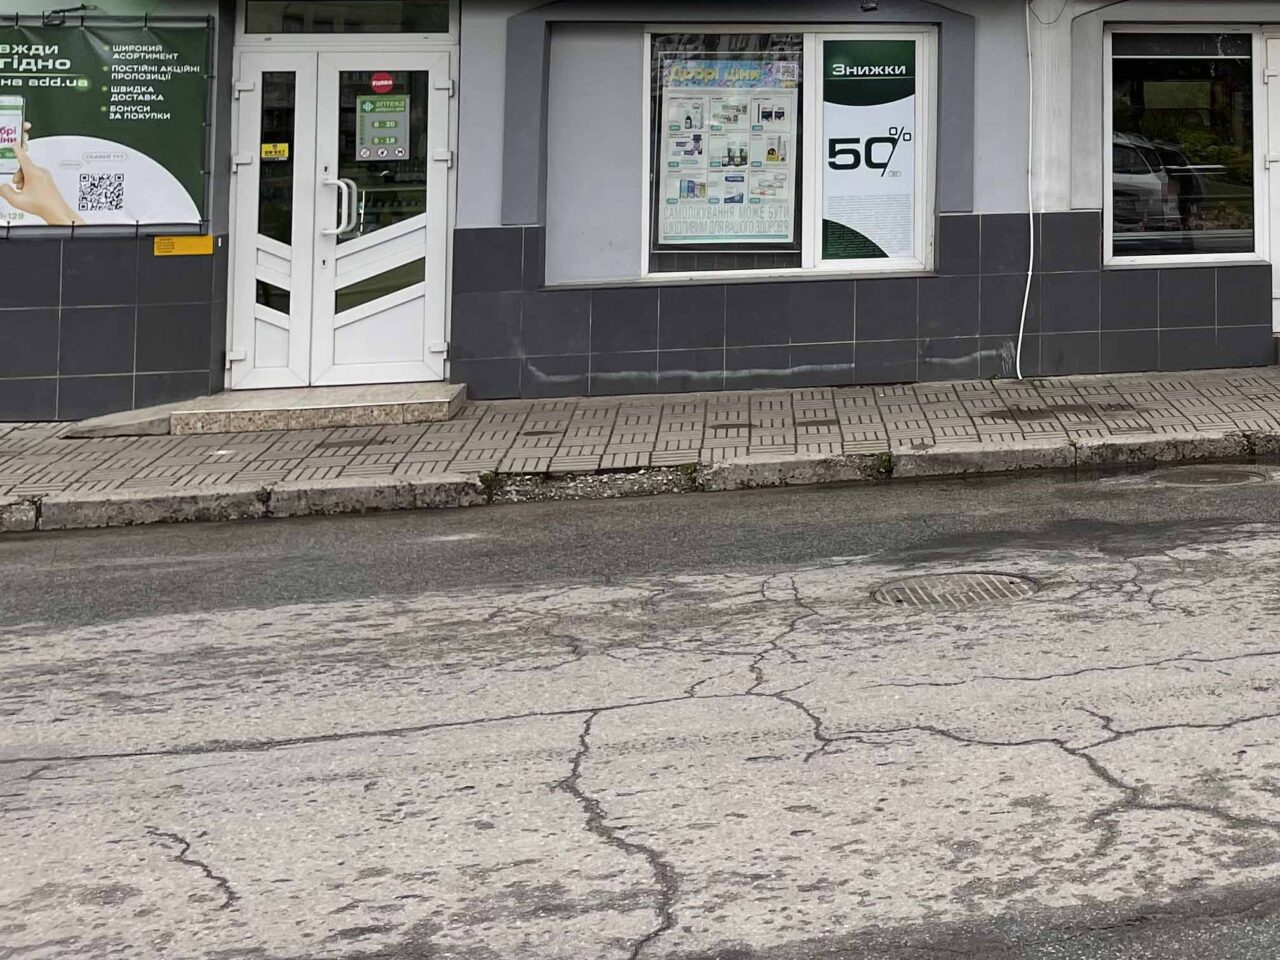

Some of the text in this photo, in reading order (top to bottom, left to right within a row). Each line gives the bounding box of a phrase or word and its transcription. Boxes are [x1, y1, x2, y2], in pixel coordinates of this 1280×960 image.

[113, 44, 163, 52] ШИРОКИЙ
[113, 52, 179, 60] АСОРТИМЕНТ
[111, 64, 200, 74] ПОСТІЙНІ АКЦІЙНІ
[832, 63, 906, 76] Знижки
[111, 72, 172, 81] ПРОПОЗИЦІЇ
[1, 77, 88, 87] на add.ua
[111, 85, 154, 93] ШВИДКА
[110, 93, 164, 102] ДОСТАВКА
[110, 105, 151, 113] БОНУСИ
[109, 112, 171, 120] ЗА ПОКУПКИ
[828, 126, 912, 177] 50%
[663, 205, 789, 221] САМОЛІКУВАННЯ МОЖЕ БУТИ
